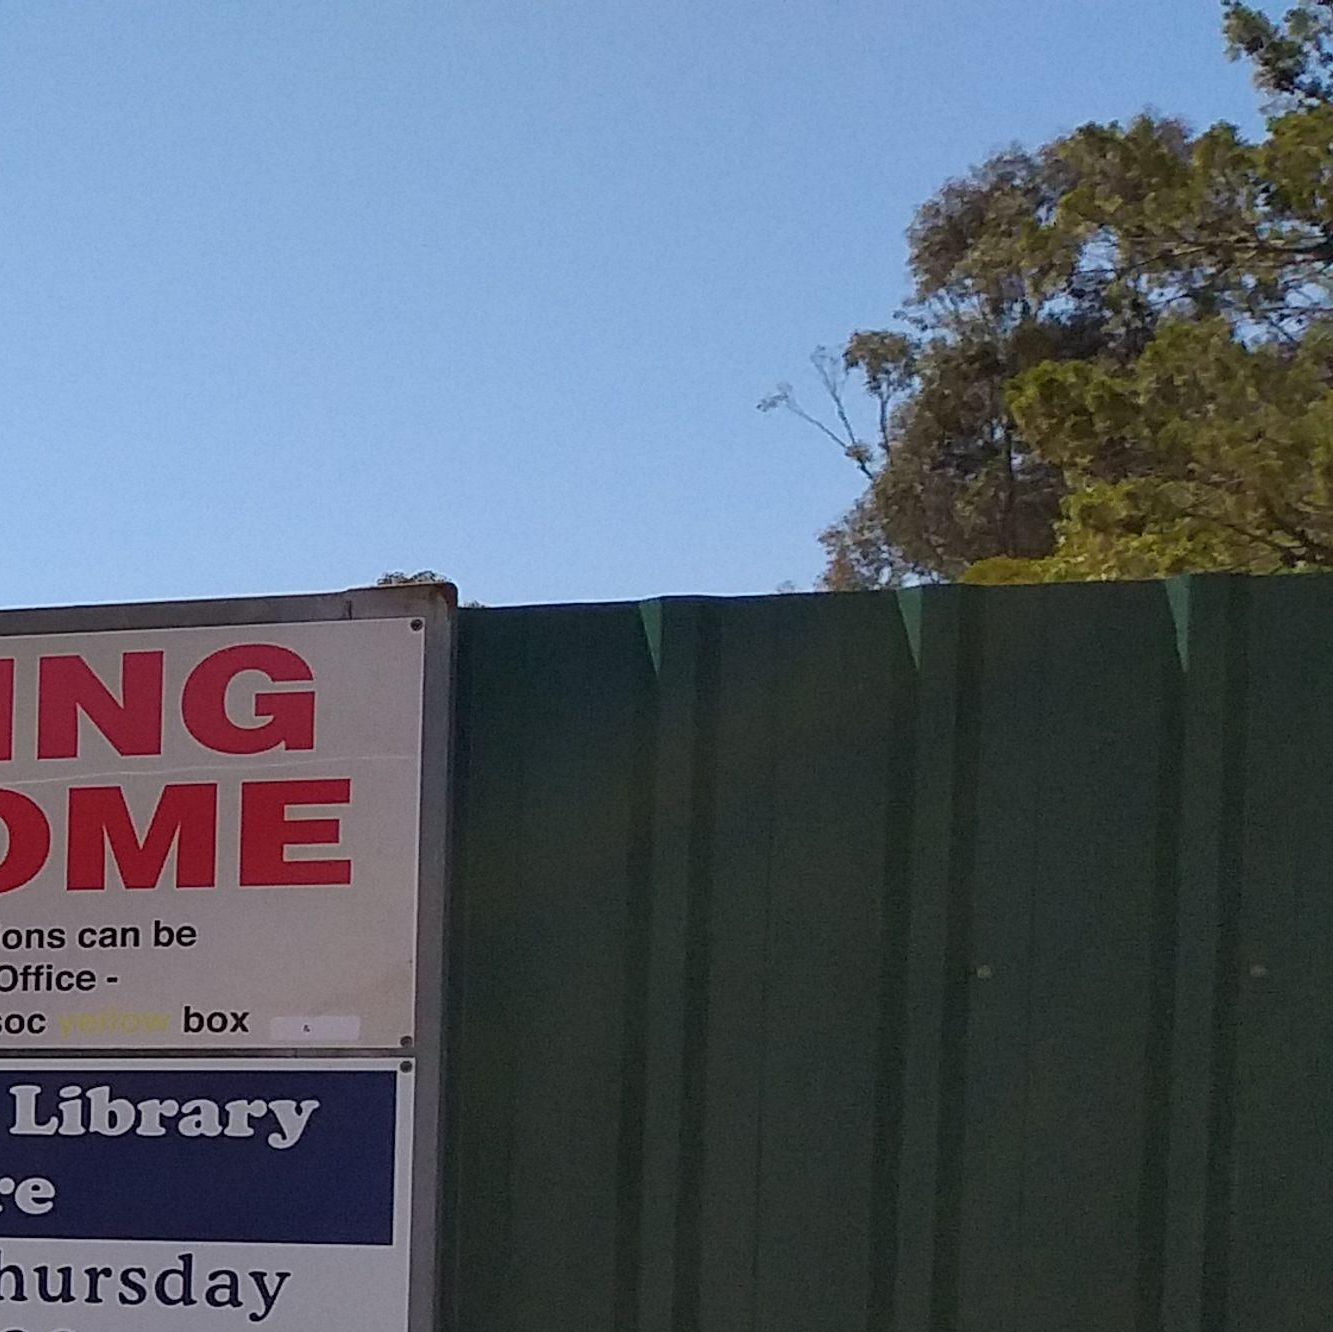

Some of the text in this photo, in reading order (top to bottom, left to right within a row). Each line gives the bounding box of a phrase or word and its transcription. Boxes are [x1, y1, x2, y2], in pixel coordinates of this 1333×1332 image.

[79, 927, 139, 948] can
[154, 920, 196, 947] be
[57, 1007, 171, 1039] yellow
[184, 1006, 249, 1032] box
[10, 1085, 319, 1149] Library
